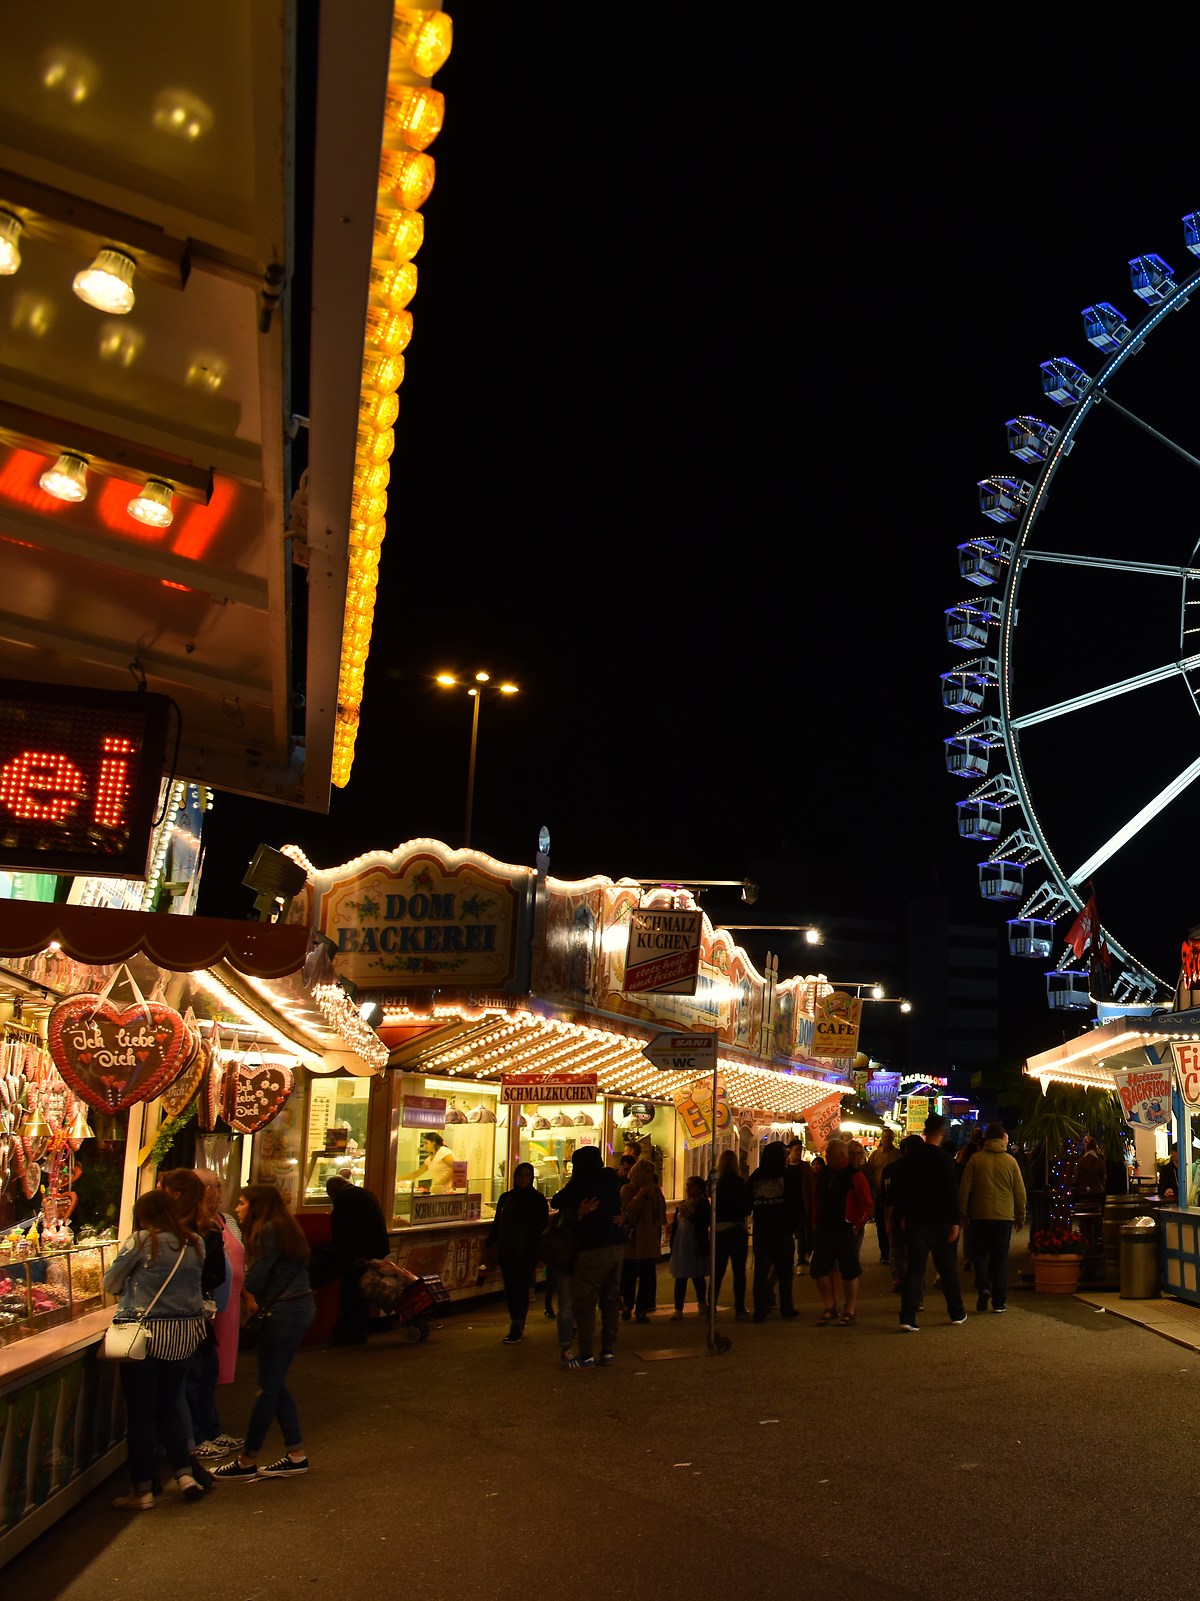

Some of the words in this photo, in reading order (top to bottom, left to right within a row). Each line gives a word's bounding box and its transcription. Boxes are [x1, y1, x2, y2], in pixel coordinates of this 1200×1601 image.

[384, 893, 457, 921] DOM
[635, 914, 696, 933] SCHMALZ
[337, 924, 498, 954] BÄCKEREI
[637, 933, 691, 950] KUCHEN
[635, 963, 659, 978] stets
[629, 976, 653, 990] und
[817, 1021, 855, 1035] CAFÉ
[70, 1029, 104, 1050] Ich
[117, 1027, 155, 1048] liebe
[675, 1039, 707, 1047] SANI
[92, 1050, 137, 1067] Dich
[673, 1058, 695, 1067] WC
[1126, 1072, 1163, 1086] Heisser
[236, 1093, 256, 1103] iebe
[504, 1086, 594, 1102] SCHMALZKUCHEN
[1120, 1080, 1170, 1111] BACKFISCH
[236, 1105, 259, 1117] Dich
[811, 1101, 841, 1130] Coffee
[415, 1198, 463, 1220] SCHMALZKUCHEN
